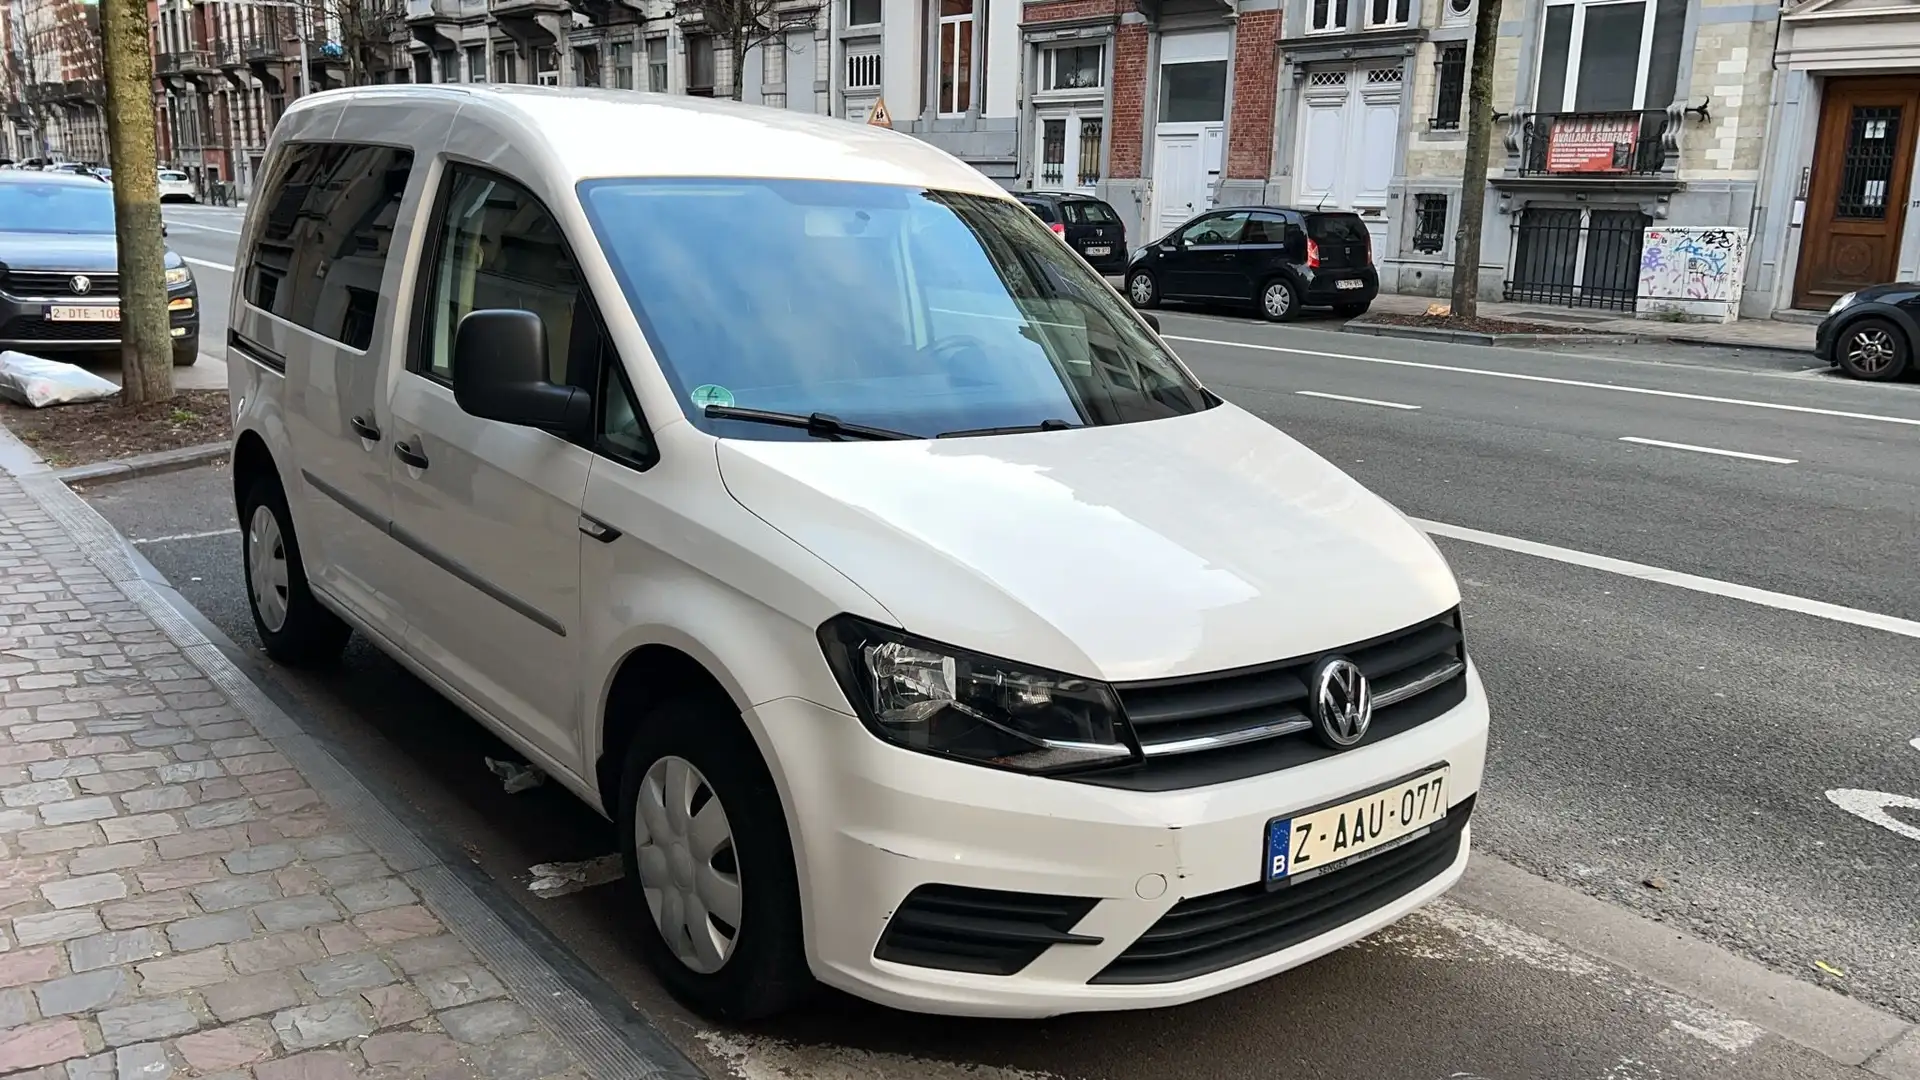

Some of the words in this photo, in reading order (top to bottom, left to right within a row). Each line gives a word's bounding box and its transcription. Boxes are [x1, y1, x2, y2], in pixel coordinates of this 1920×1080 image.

[1553, 133, 1596, 143] AVAILABLE
[1596, 132, 1634, 144] SURFACE
[1271, 854, 1287, 875] B
[1293, 776, 1443, 865] Z-AAU-077
